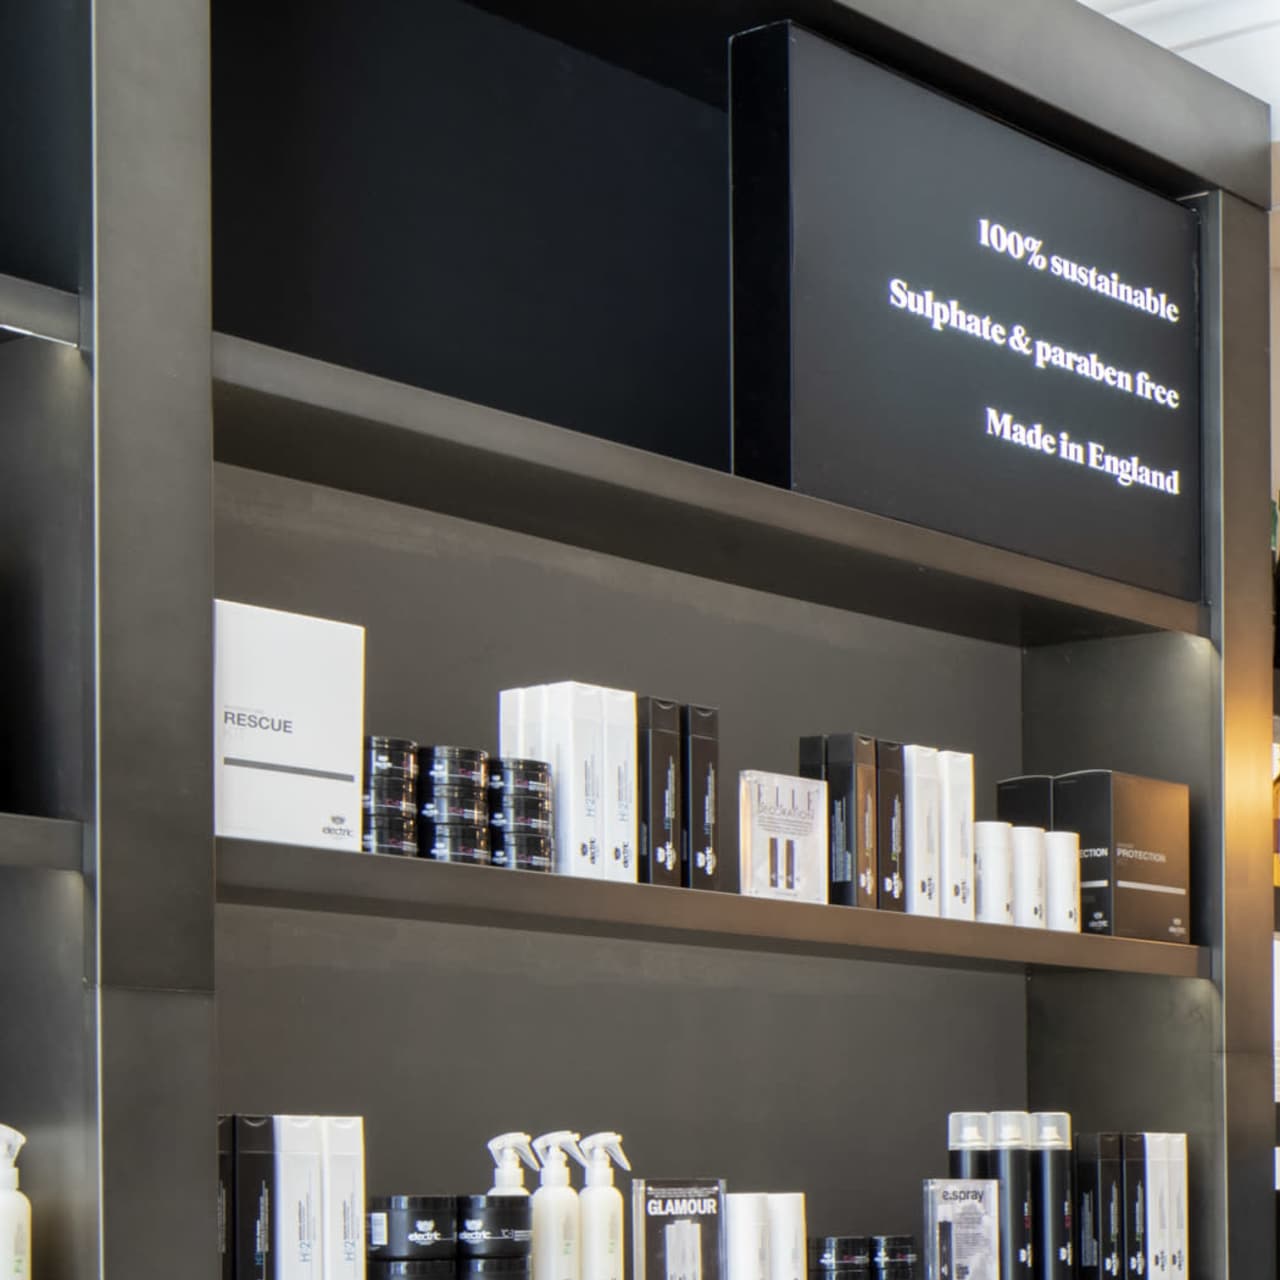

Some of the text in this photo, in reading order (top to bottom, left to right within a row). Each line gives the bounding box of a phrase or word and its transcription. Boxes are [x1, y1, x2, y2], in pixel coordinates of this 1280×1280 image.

[979, 219, 1180, 322] 100% sustainable
[889, 278, 1180, 408] Sulphate & paraben free
[986, 407, 1180, 495] Made in England
[223, 710, 294, 734] RESCUE
[1116, 848, 1167, 863] PROTECTION
[942, 1189, 985, 1203] e.spray
[647, 1199, 718, 1215] GLAMOUR
[408, 1231, 441, 1241] electric
[458, 1231, 492, 1240] electric
